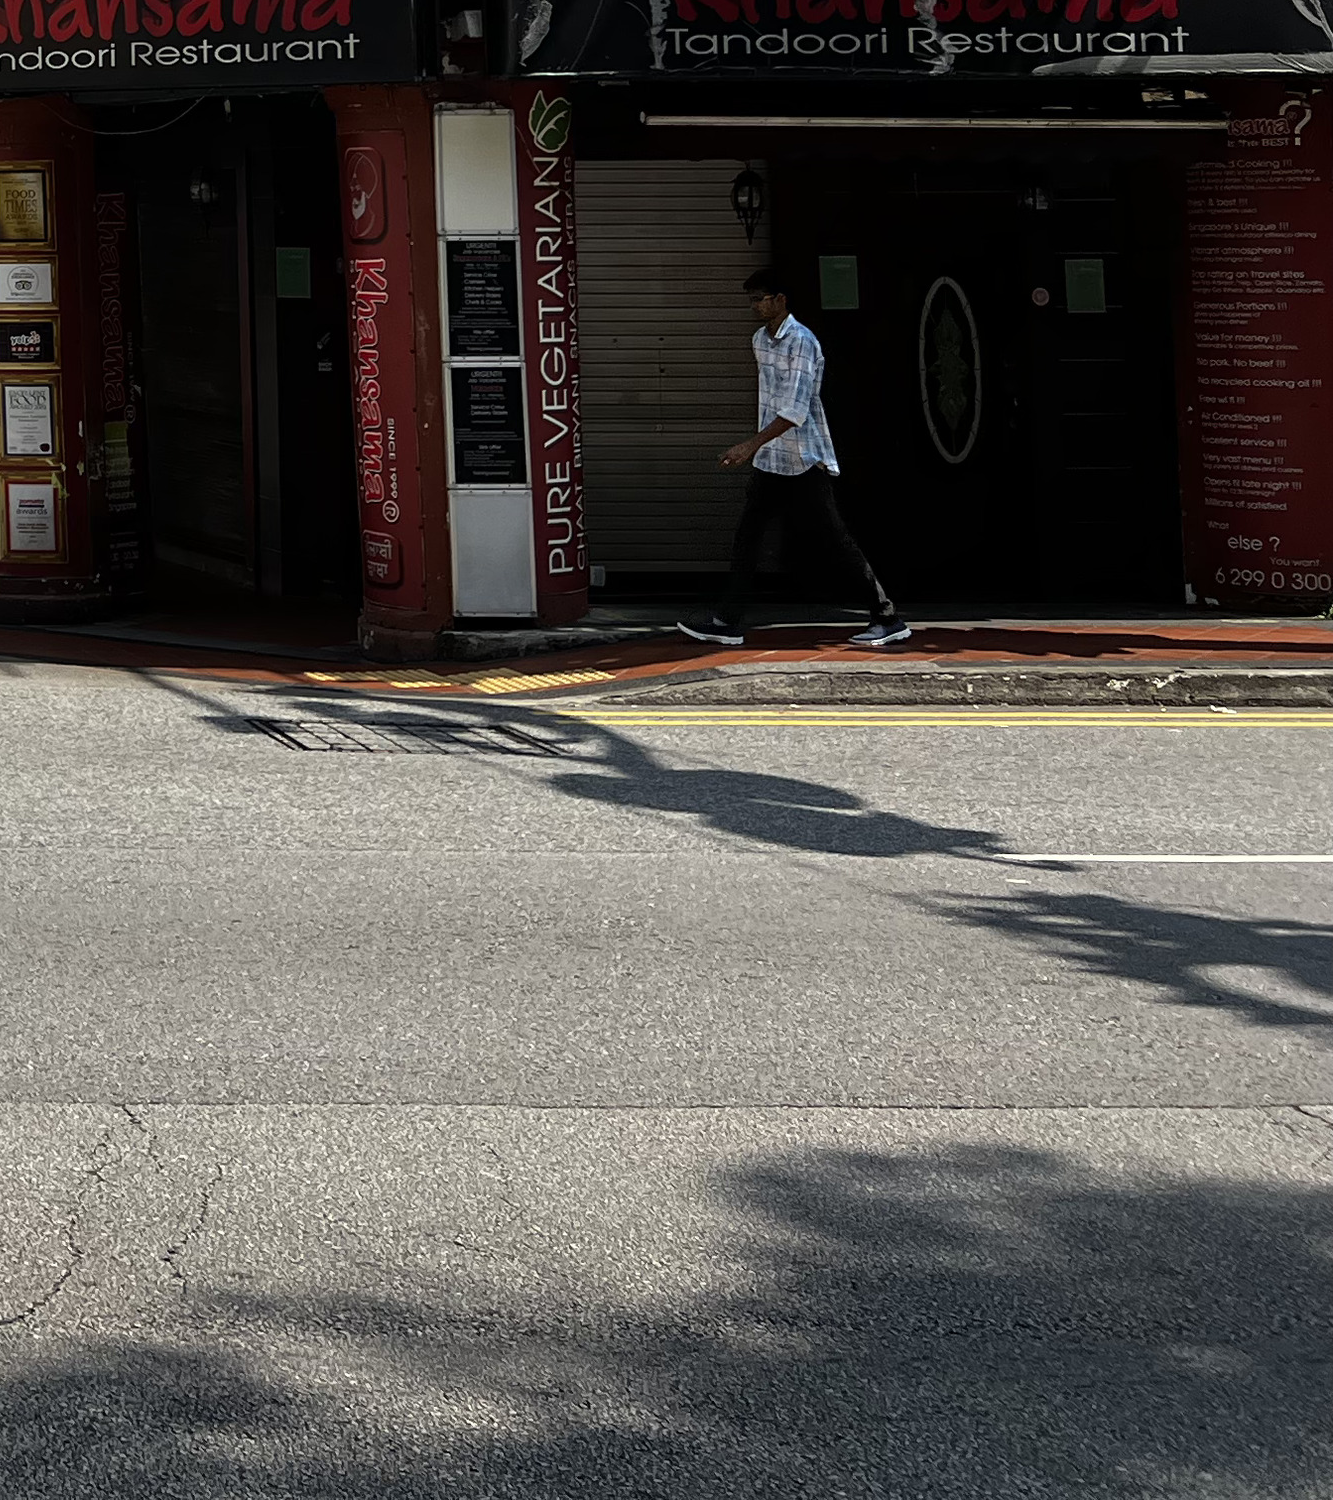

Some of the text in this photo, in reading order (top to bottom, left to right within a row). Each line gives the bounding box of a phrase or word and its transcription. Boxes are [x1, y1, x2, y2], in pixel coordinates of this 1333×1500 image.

[666, 26, 1191, 55] Tandoori Restaurant
[130, 33, 361, 67] Restaurant
[1261, 137, 1289, 146] BEST
[1236, 159, 1280, 169] Cooking
[5, 189, 36, 199] FOOD
[4, 200, 38, 213] TIMES
[1240, 222, 1277, 231] Unique
[1221, 247, 1282, 256] atmosphere
[1206, 270, 1234, 280] rating
[1251, 270, 1281, 278] travel
[1281, 270, 1305, 278] sites
[95, 191, 126, 412] Khansama
[1193, 301, 1234, 309] Generous
[1235, 302, 1276, 311] Portions
[567, 258, 580, 359] SNACKS
[1195, 332, 1220, 341] Value
[1235, 334, 1270, 343] money
[533, 156, 574, 576] PURE VEGETARIAN
[1196, 358, 1208, 366] No
[1248, 359, 1274, 368] beef
[354, 258, 389, 504] Khansama
[1211, 378, 1251, 386] recycled
[1252, 378, 1295, 389] cooking
[1297, 379, 1310, 387] oil
[1198, 394, 1216, 403] Free
[570, 373, 583, 469] BIRYANI
[1212, 412, 1271, 423] Conditioned
[1240, 439, 1275, 447] service
[386, 417, 399, 500] SINCE 1999
[1202, 453, 1221, 462] Very
[1242, 457, 1272, 465] menu
[1203, 476, 1232, 487] Opens
[1242, 479, 1261, 488] late
[1262, 480, 1290, 491] night
[1204, 497, 1288, 511] Millions of satisfied
[573, 484, 588, 571] CHAAT
[1206, 520, 1229, 530] What
[1227, 534, 1281, 552] else ?
[1269, 556, 1290, 567] You
[1215, 566, 1332, 591] 6 299 0 300
